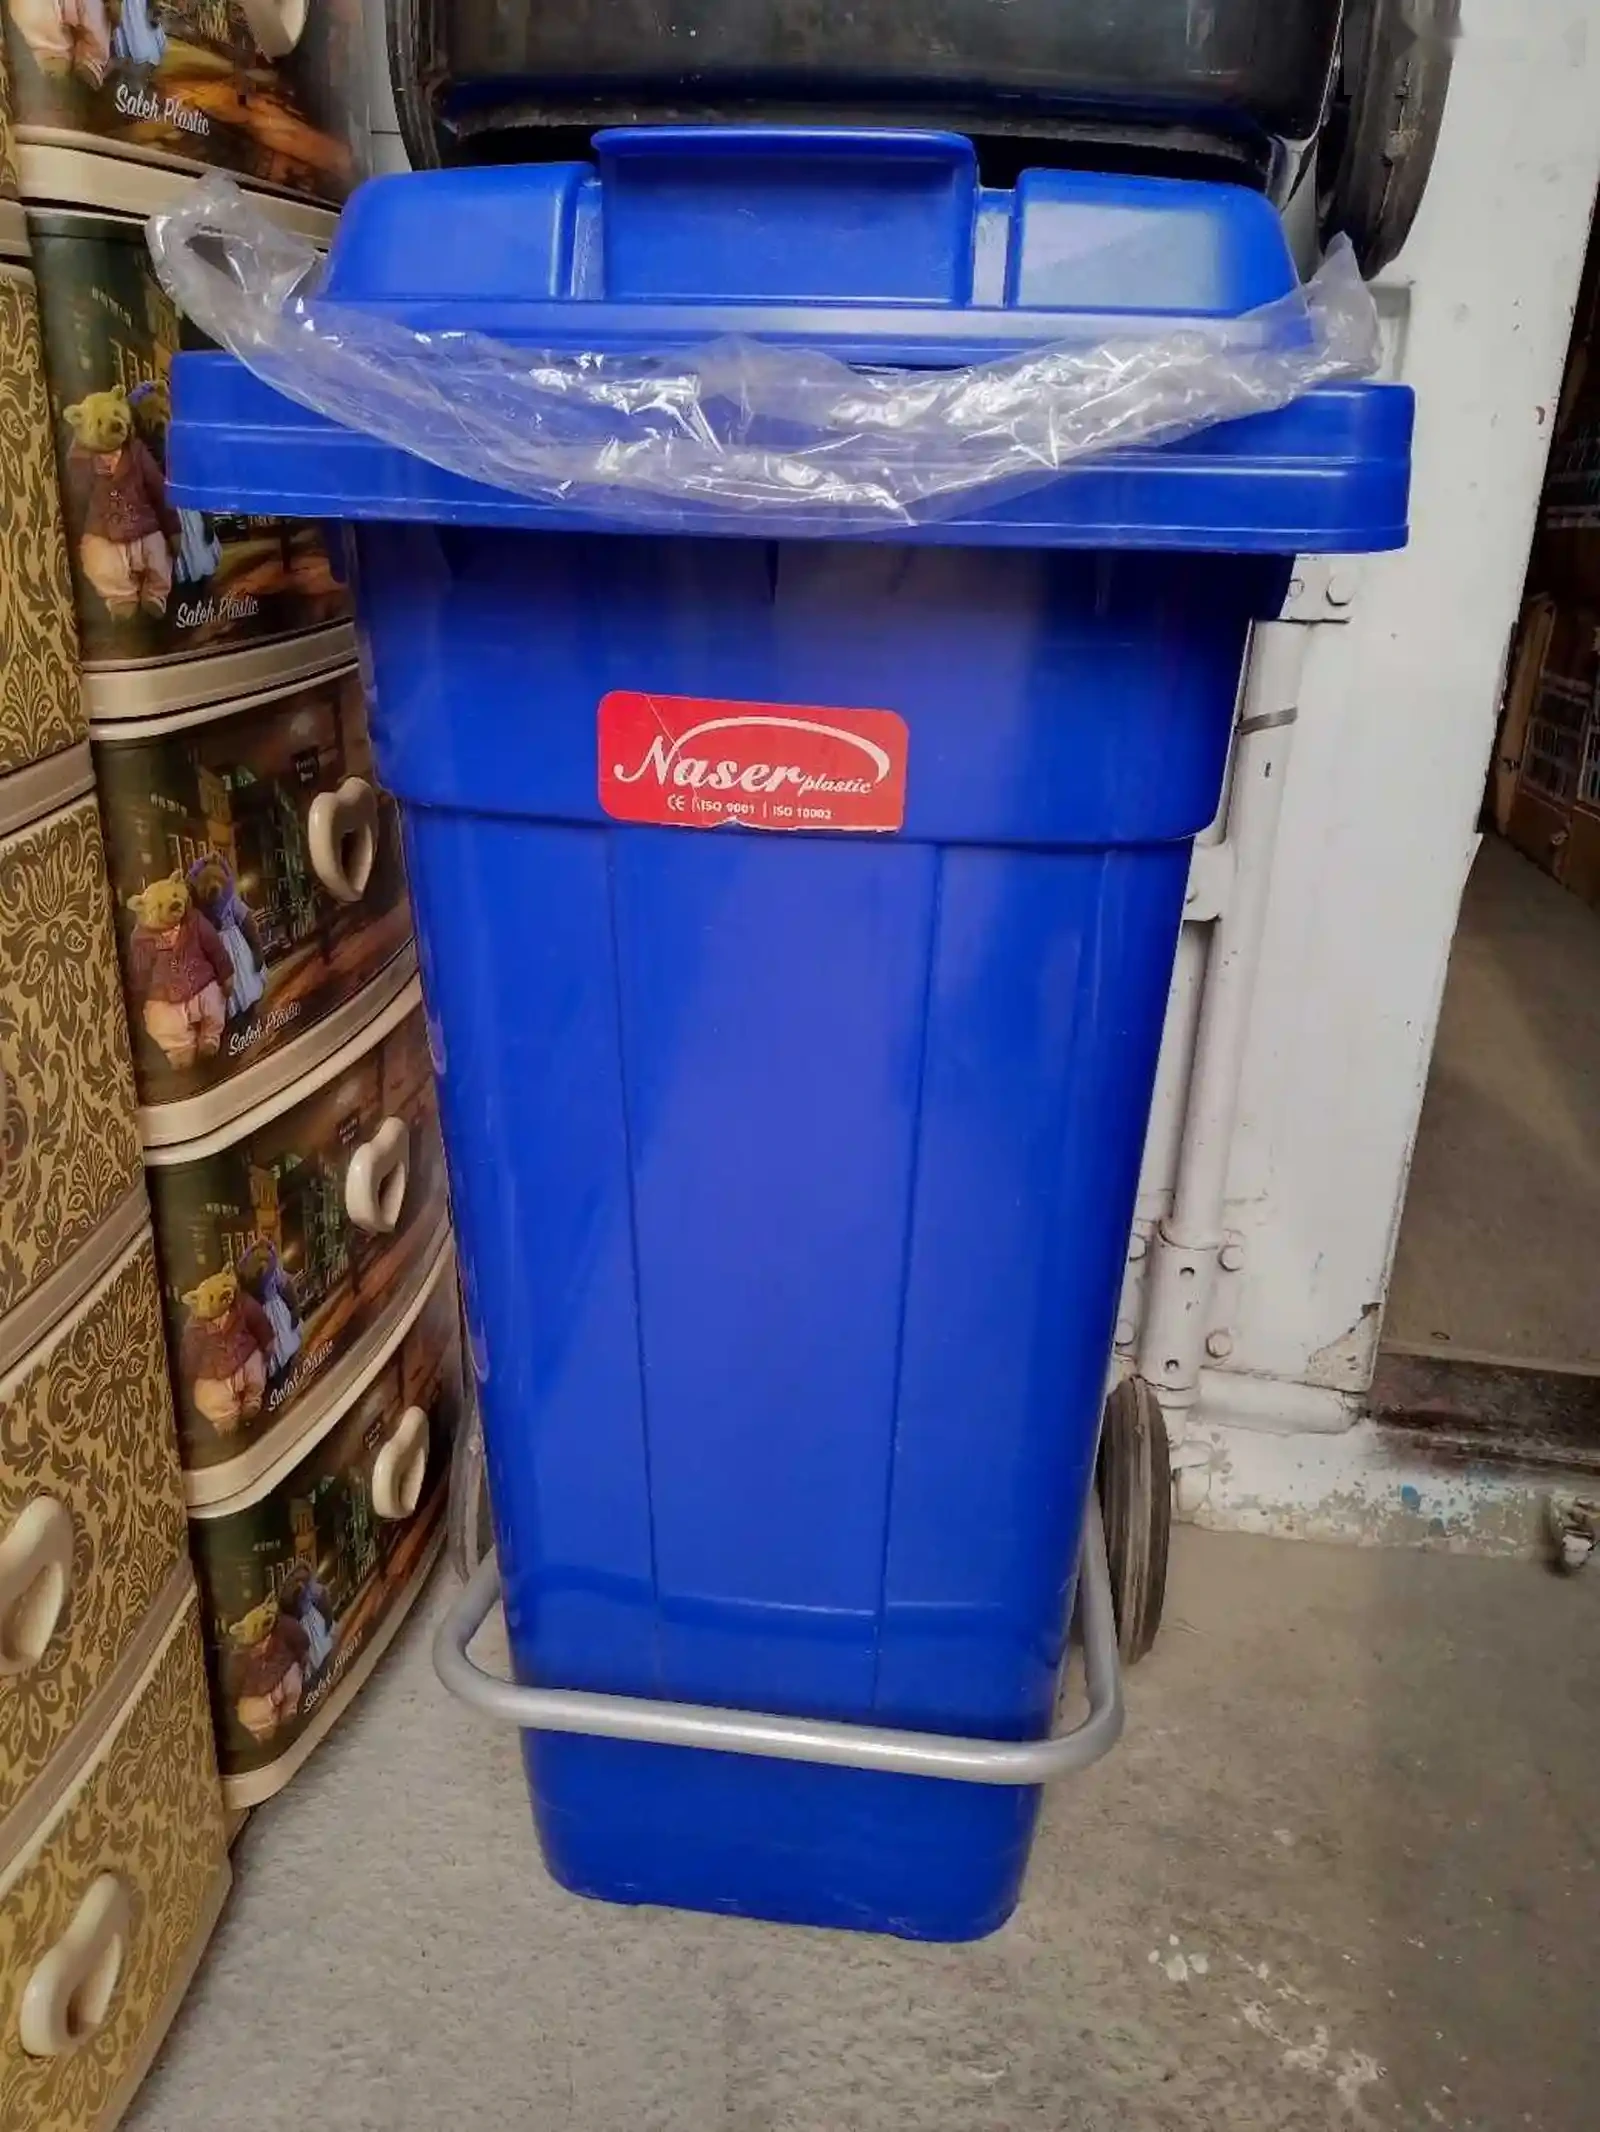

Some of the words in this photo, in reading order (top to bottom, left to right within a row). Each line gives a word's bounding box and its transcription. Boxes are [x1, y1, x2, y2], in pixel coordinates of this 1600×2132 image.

[115, 84, 160, 121] Saleh
[163, 97, 210, 136] Plastic
[176, 596, 216, 628] Saleh
[613, 735, 803, 792] Naser
[798, 772, 874, 797] plastic
[701, 799, 722, 812] ISO
[773, 805, 793, 816] ISO
